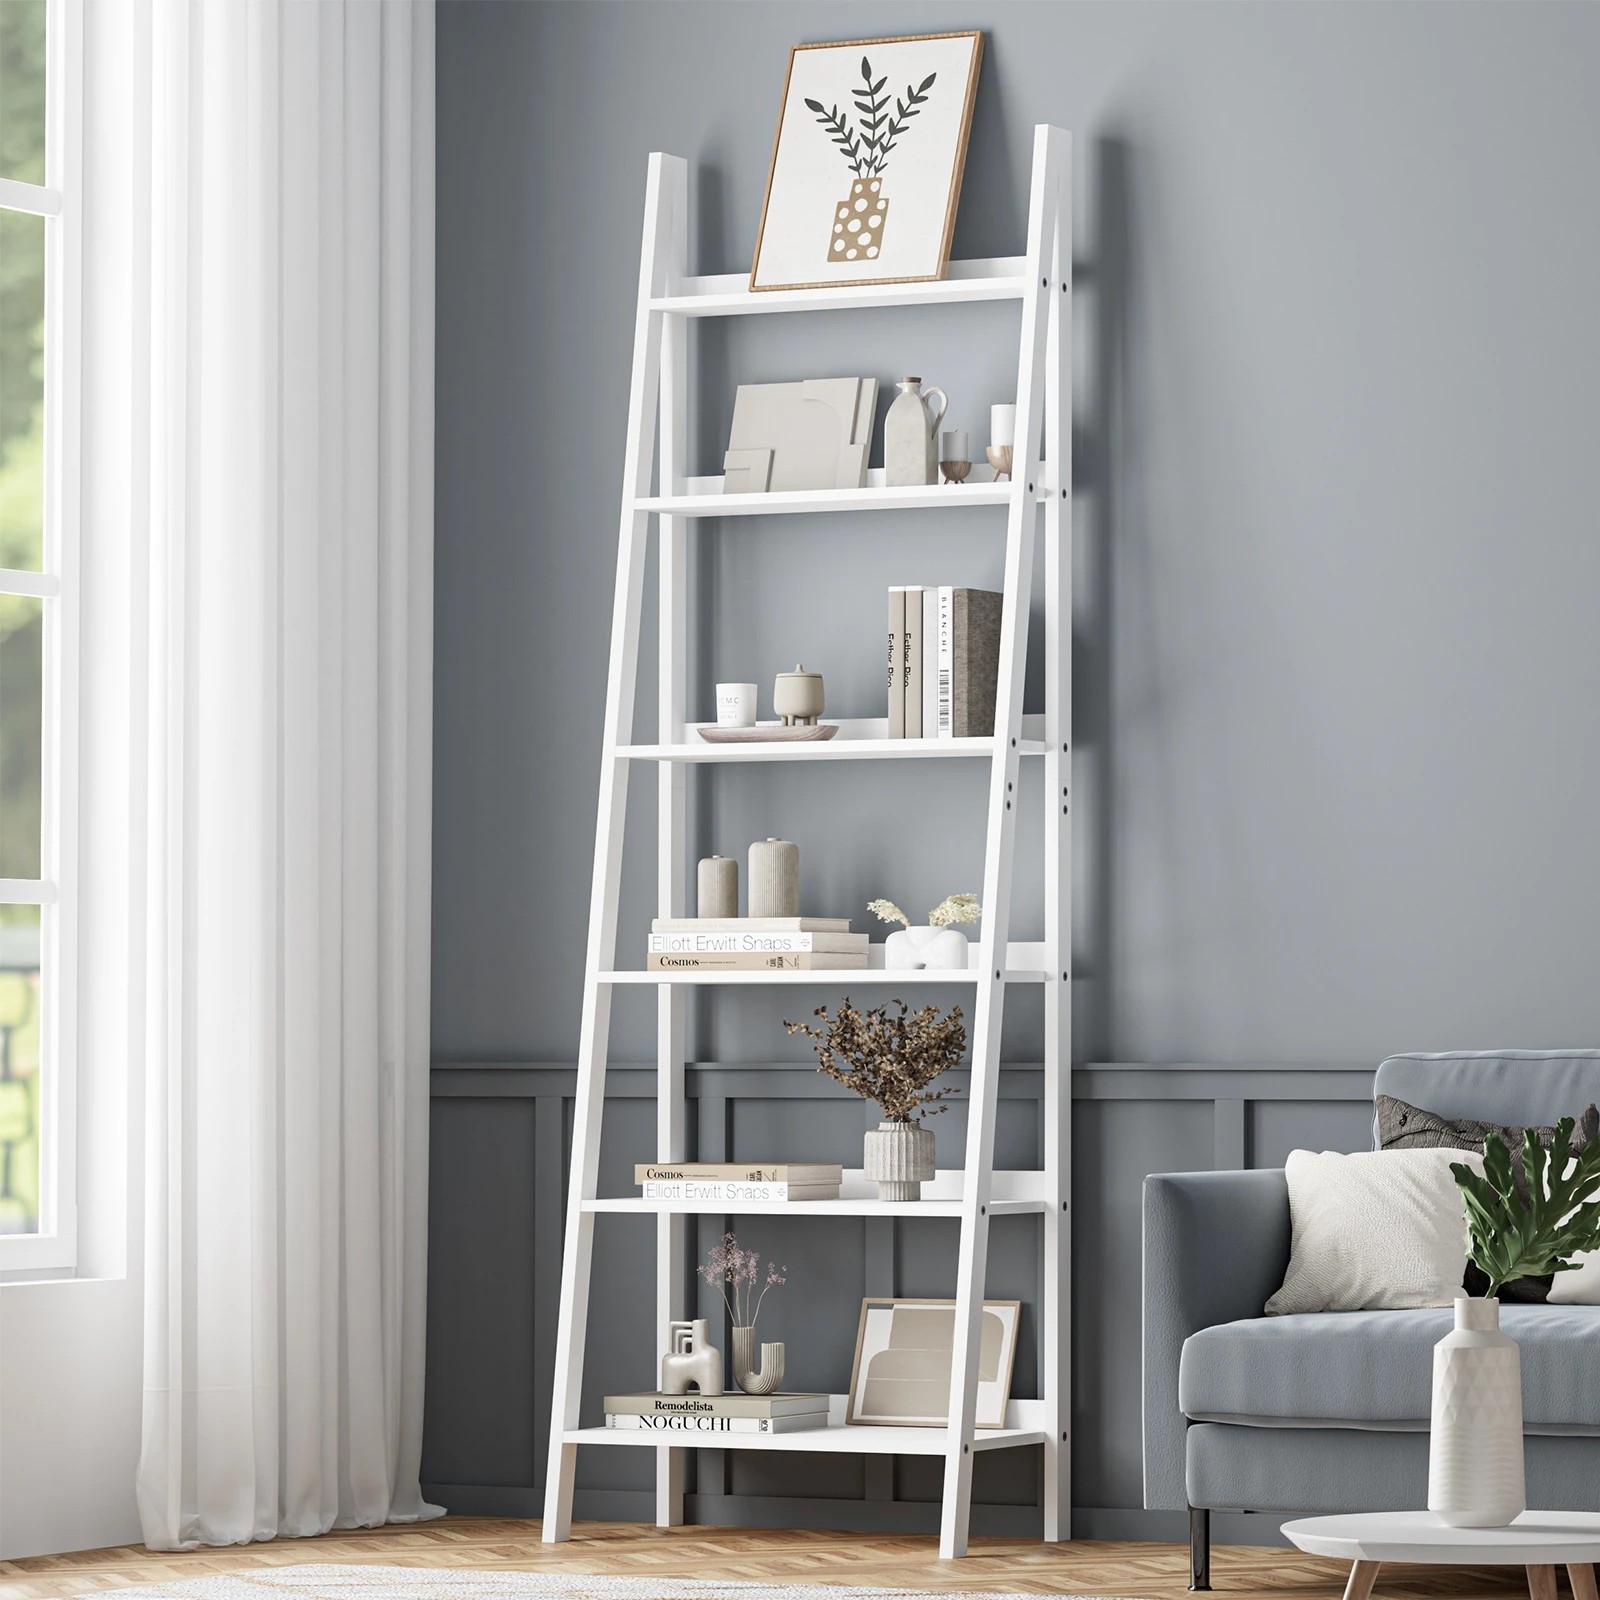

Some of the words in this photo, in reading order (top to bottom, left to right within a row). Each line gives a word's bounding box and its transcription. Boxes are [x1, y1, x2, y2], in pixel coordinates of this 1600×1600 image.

[652, 935, 691, 951] Elliott
[696, 935, 737, 951] Erwitt
[742, 934, 792, 953] Snaps
[659, 955, 700, 967] Cosmos
[646, 1167, 684, 1179] Cosmos
[646, 1182, 681, 1199] Elliott
[685, 1182, 722, 1199] Erwitt
[726, 1183, 770, 1202] Snaps
[654, 1400, 714, 1412] Remodelista
[639, 1415, 731, 1432] NOGUCHI
